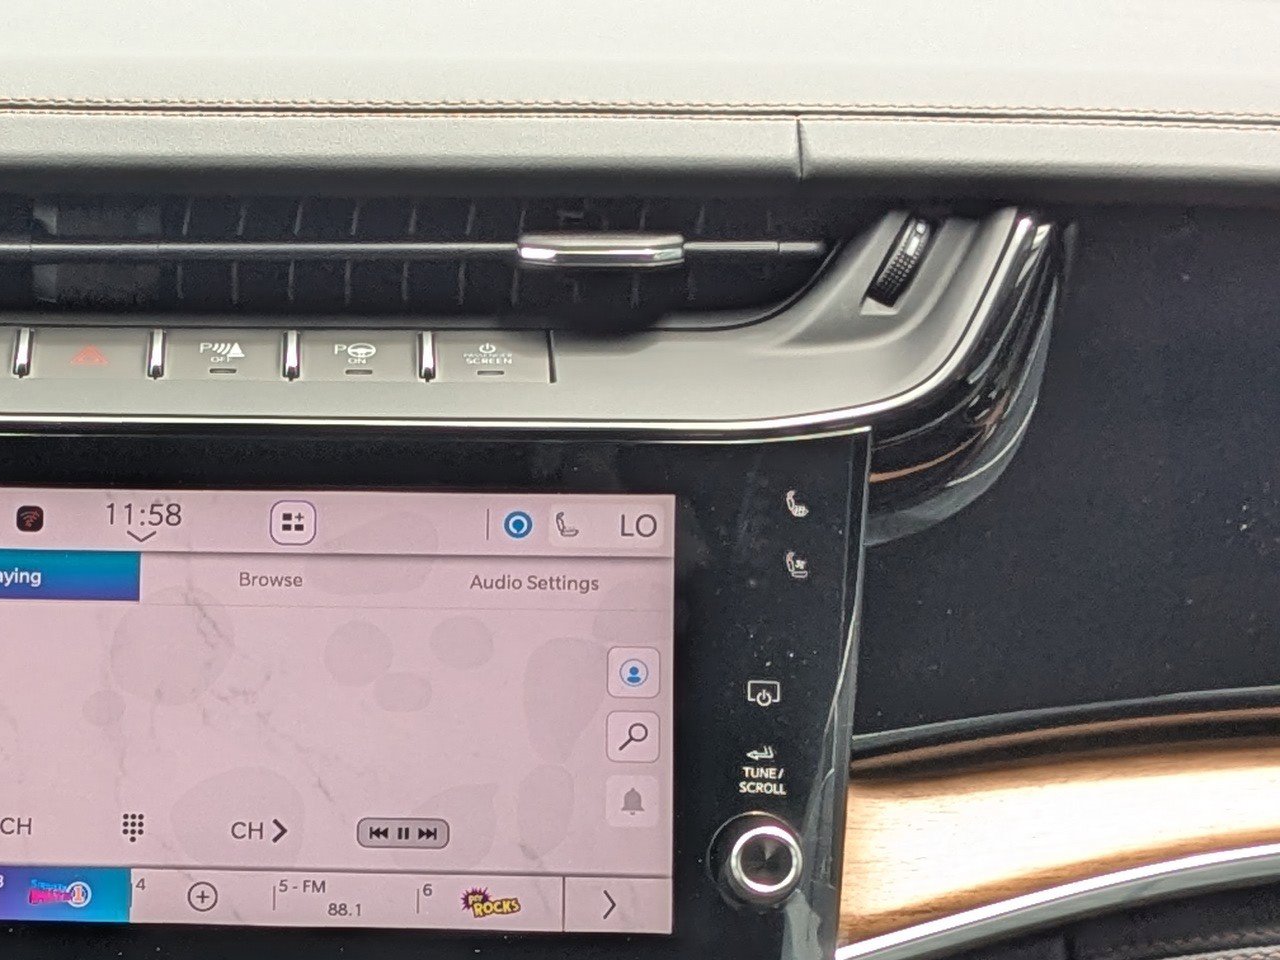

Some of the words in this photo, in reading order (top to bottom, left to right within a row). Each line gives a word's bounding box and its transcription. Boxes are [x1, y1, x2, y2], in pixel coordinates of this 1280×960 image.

[105, 502, 182, 528] 11:58
[620, 513, 658, 539] LO
[239, 570, 303, 589] Browse
[470, 573, 522, 592] Audio
[527, 573, 600, 595] Settings
[742, 766, 785, 780] TUNE/
[739, 781, 786, 795] SCROLL
[0, 817, 32, 835] CH
[231, 821, 264, 840] CH
[135, 878, 146, 891] 4
[279, 880, 288, 893] 5
[302, 880, 326, 894] FM
[422, 884, 432, 897] 6
[328, 902, 362, 917] 88.1
[473, 899, 519, 916] ROCKS
